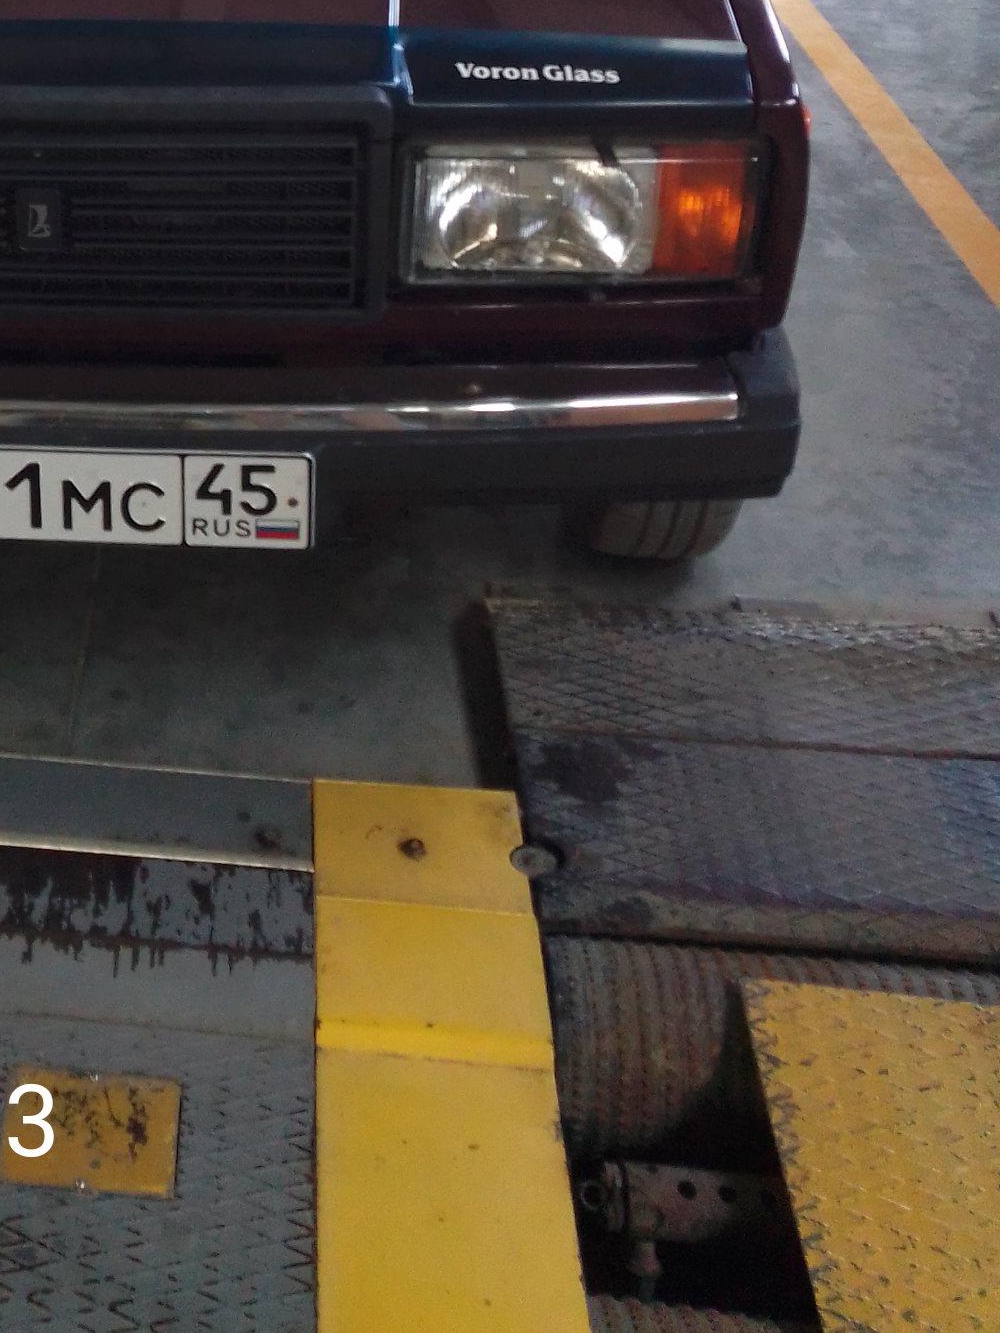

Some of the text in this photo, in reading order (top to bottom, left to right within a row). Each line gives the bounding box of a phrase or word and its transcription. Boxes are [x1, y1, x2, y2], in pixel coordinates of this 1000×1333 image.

[454, 62, 621, 84] Voron Glass
[196, 463, 278, 516] 45
[191, 518, 253, 539] RUS
